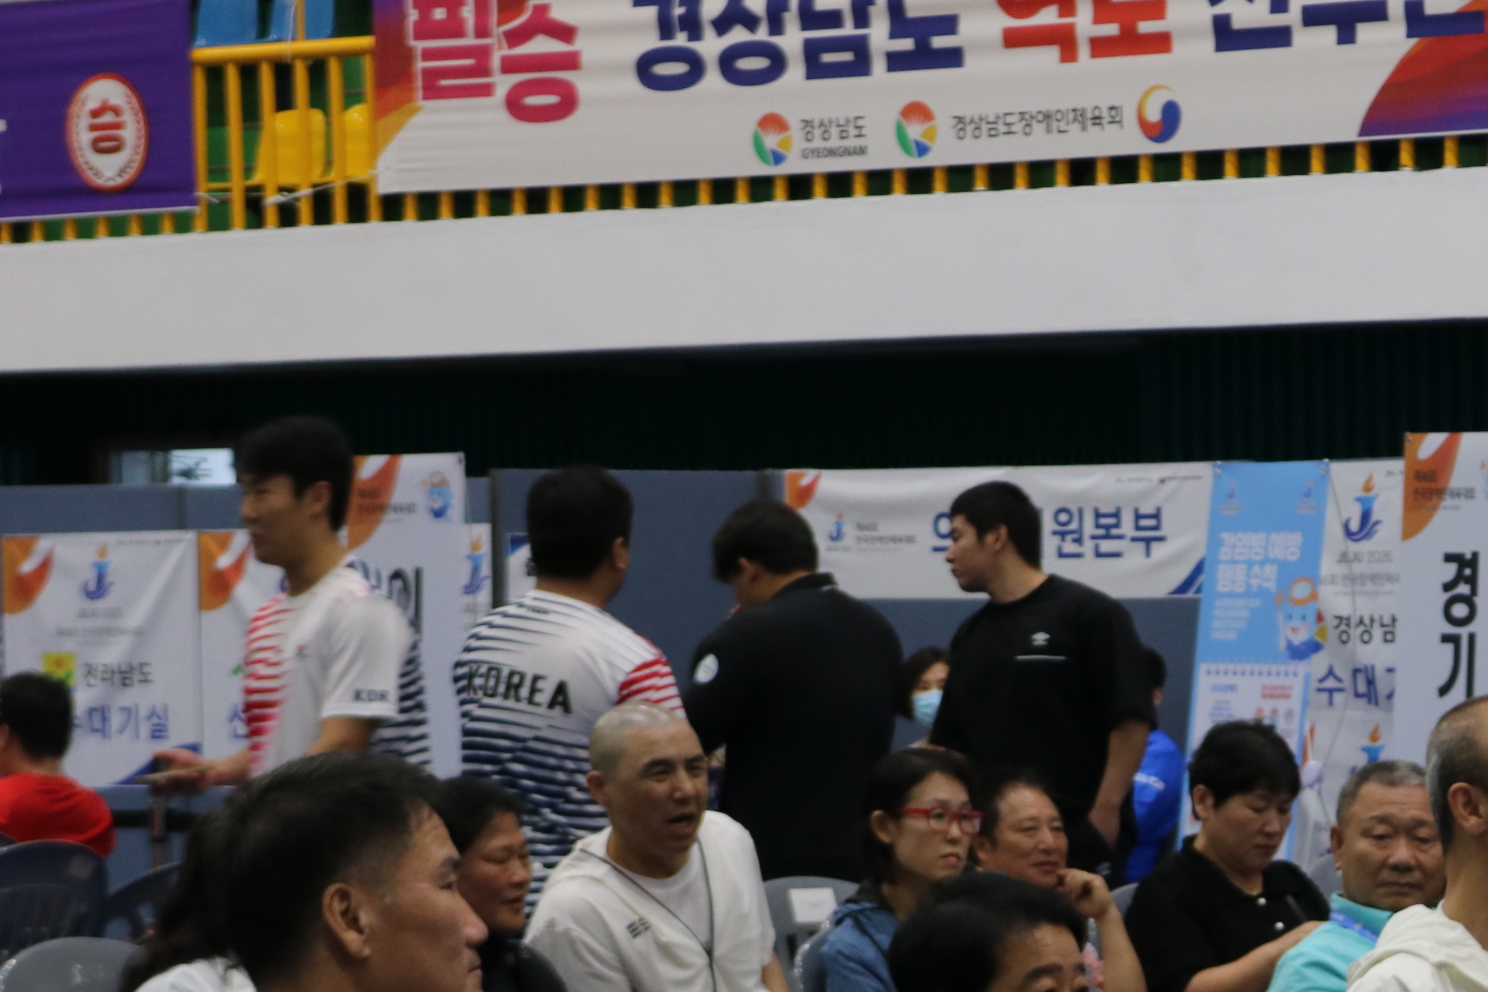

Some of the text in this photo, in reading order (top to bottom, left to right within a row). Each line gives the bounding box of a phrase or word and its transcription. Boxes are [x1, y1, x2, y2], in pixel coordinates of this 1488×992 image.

[801, 103, 1125, 142] 경상남도 경상남도장애인체육회
[801, 143, 869, 160] GYEONGNAM
[1333, 613, 1398, 646] 경상남
[83, 661, 155, 688] 전라남도
[464, 663, 573, 715] KOREA
[72, 703, 169, 740] 대기실
